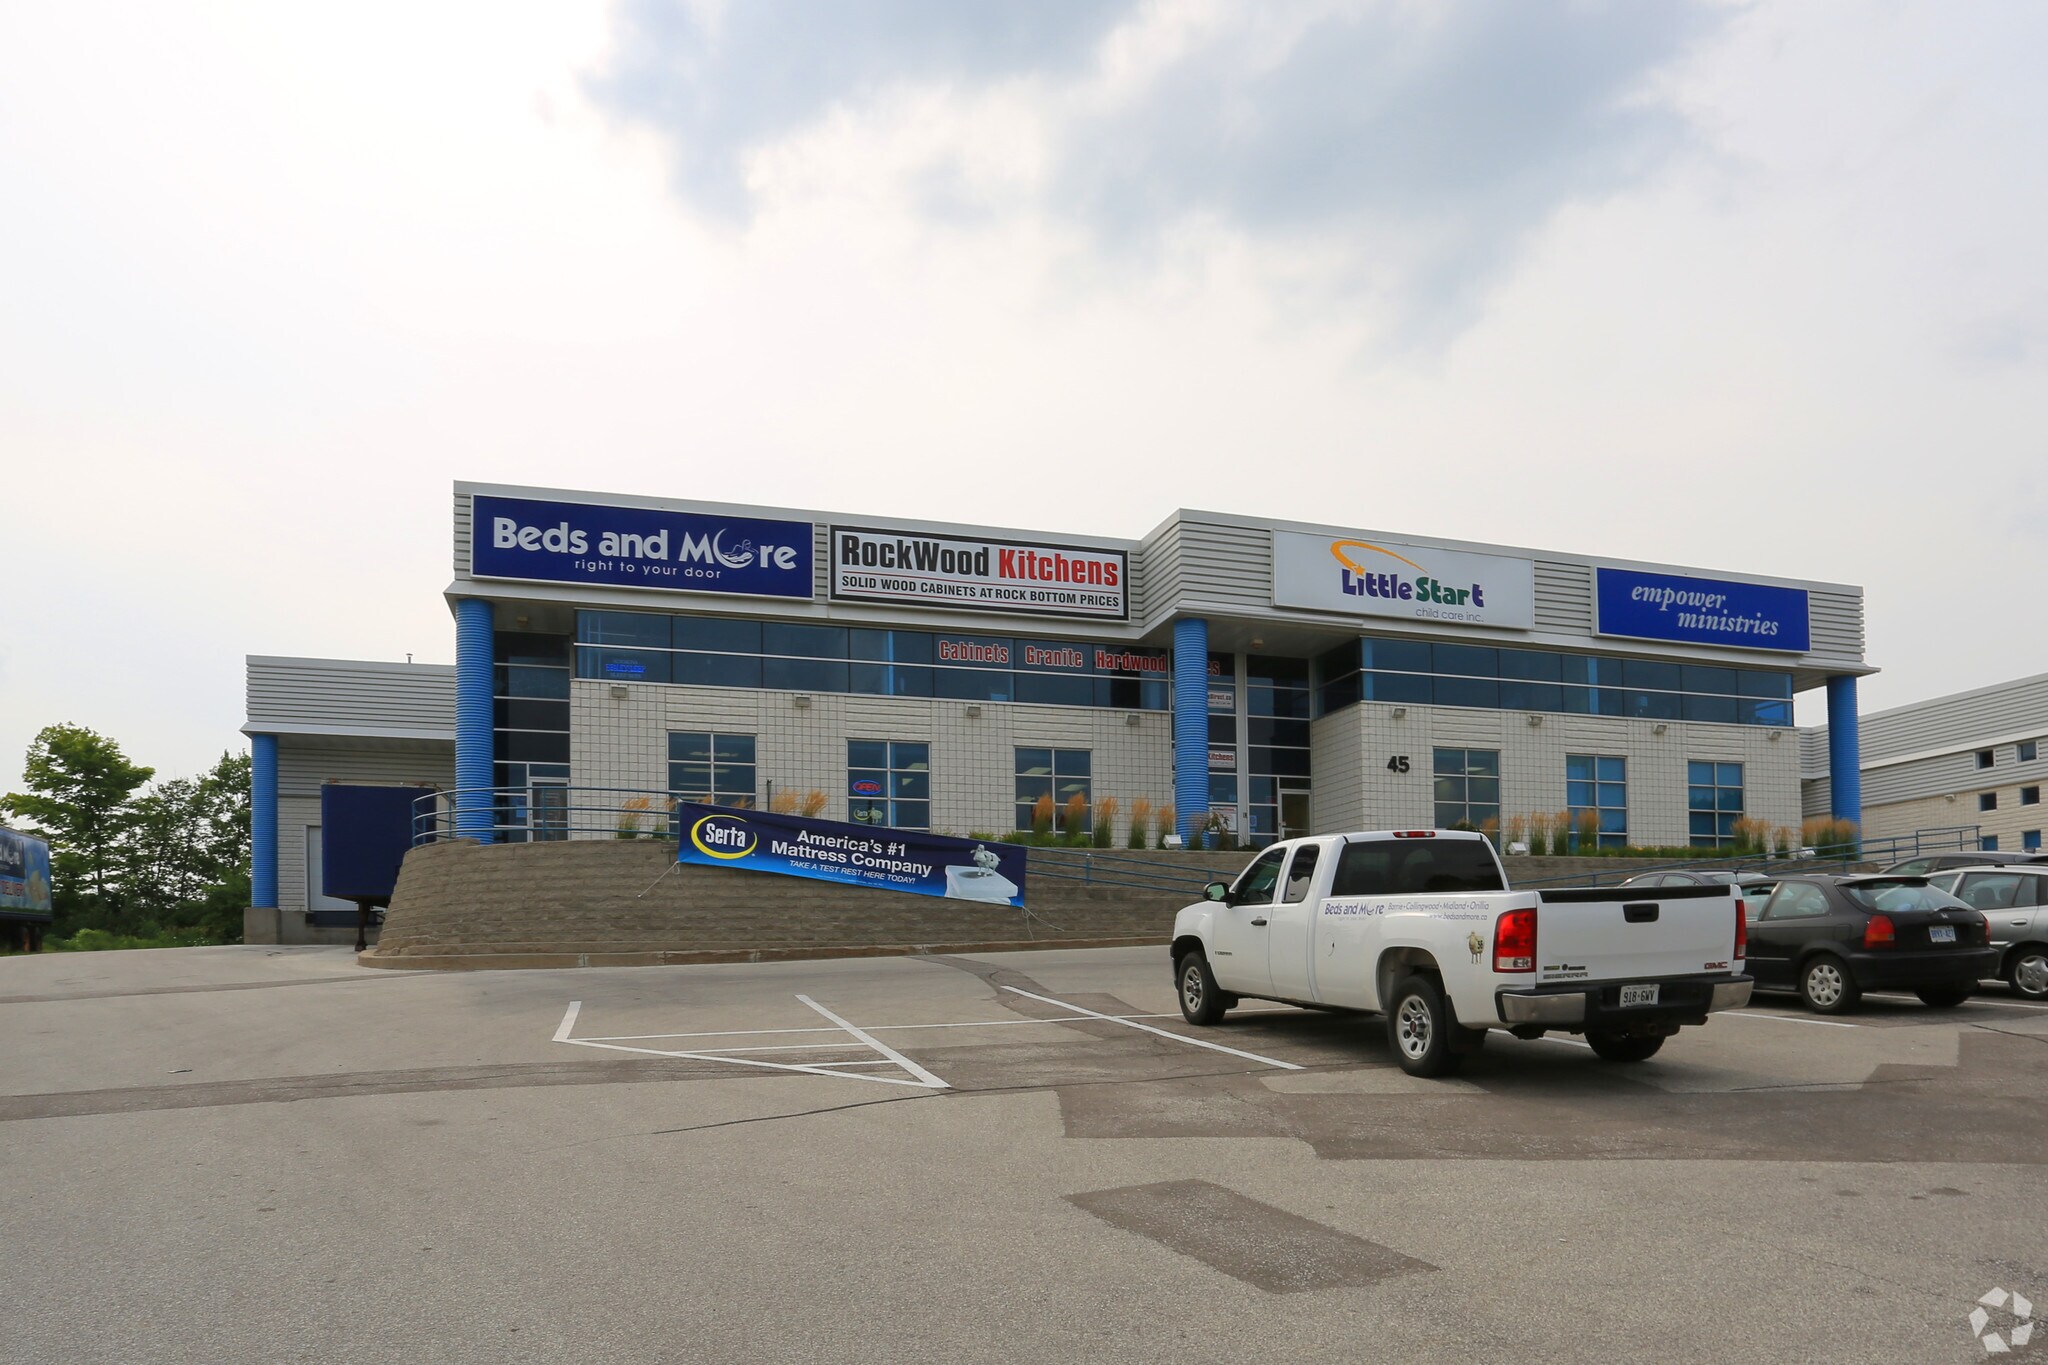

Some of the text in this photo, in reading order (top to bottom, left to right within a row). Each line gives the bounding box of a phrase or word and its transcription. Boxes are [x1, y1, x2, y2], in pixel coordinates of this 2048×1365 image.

[493, 517, 588, 554] Beds
[598, 529, 668, 559] and
[575, 559, 721, 579] right to your door
[841, 535, 1118, 586] RockWood Kitchens
[842, 575, 1119, 607] SOLID WOOD CABINETS AT ROCK BOTTOM PRICES
[1631, 585, 1726, 612] empower
[1415, 607, 1484, 622] child care inc.
[1678, 606, 1779, 636] ministries
[939, 640, 1009, 663] Cabinets
[1025, 646, 1083, 668] Granite
[1095, 650, 1167, 673] Hardwood
[1387, 756, 1410, 773] 45
[856, 783, 881, 791] OPEN
[705, 823, 746, 848] Serta
[797, 830, 906, 857] America's #1
[771, 840, 932, 877] Mattress Company
[790, 860, 810, 869] TAKE
[819, 864, 840, 873] TEST
[841, 867, 861, 876] REST
[863, 870, 885, 880] HERE
[887, 874, 915, 885] TODAY!
[1325, 903, 1342, 915] Beds
[1343, 903, 1357, 915] and
[1429, 913, 1488, 921] www.bedsandmore.ca
